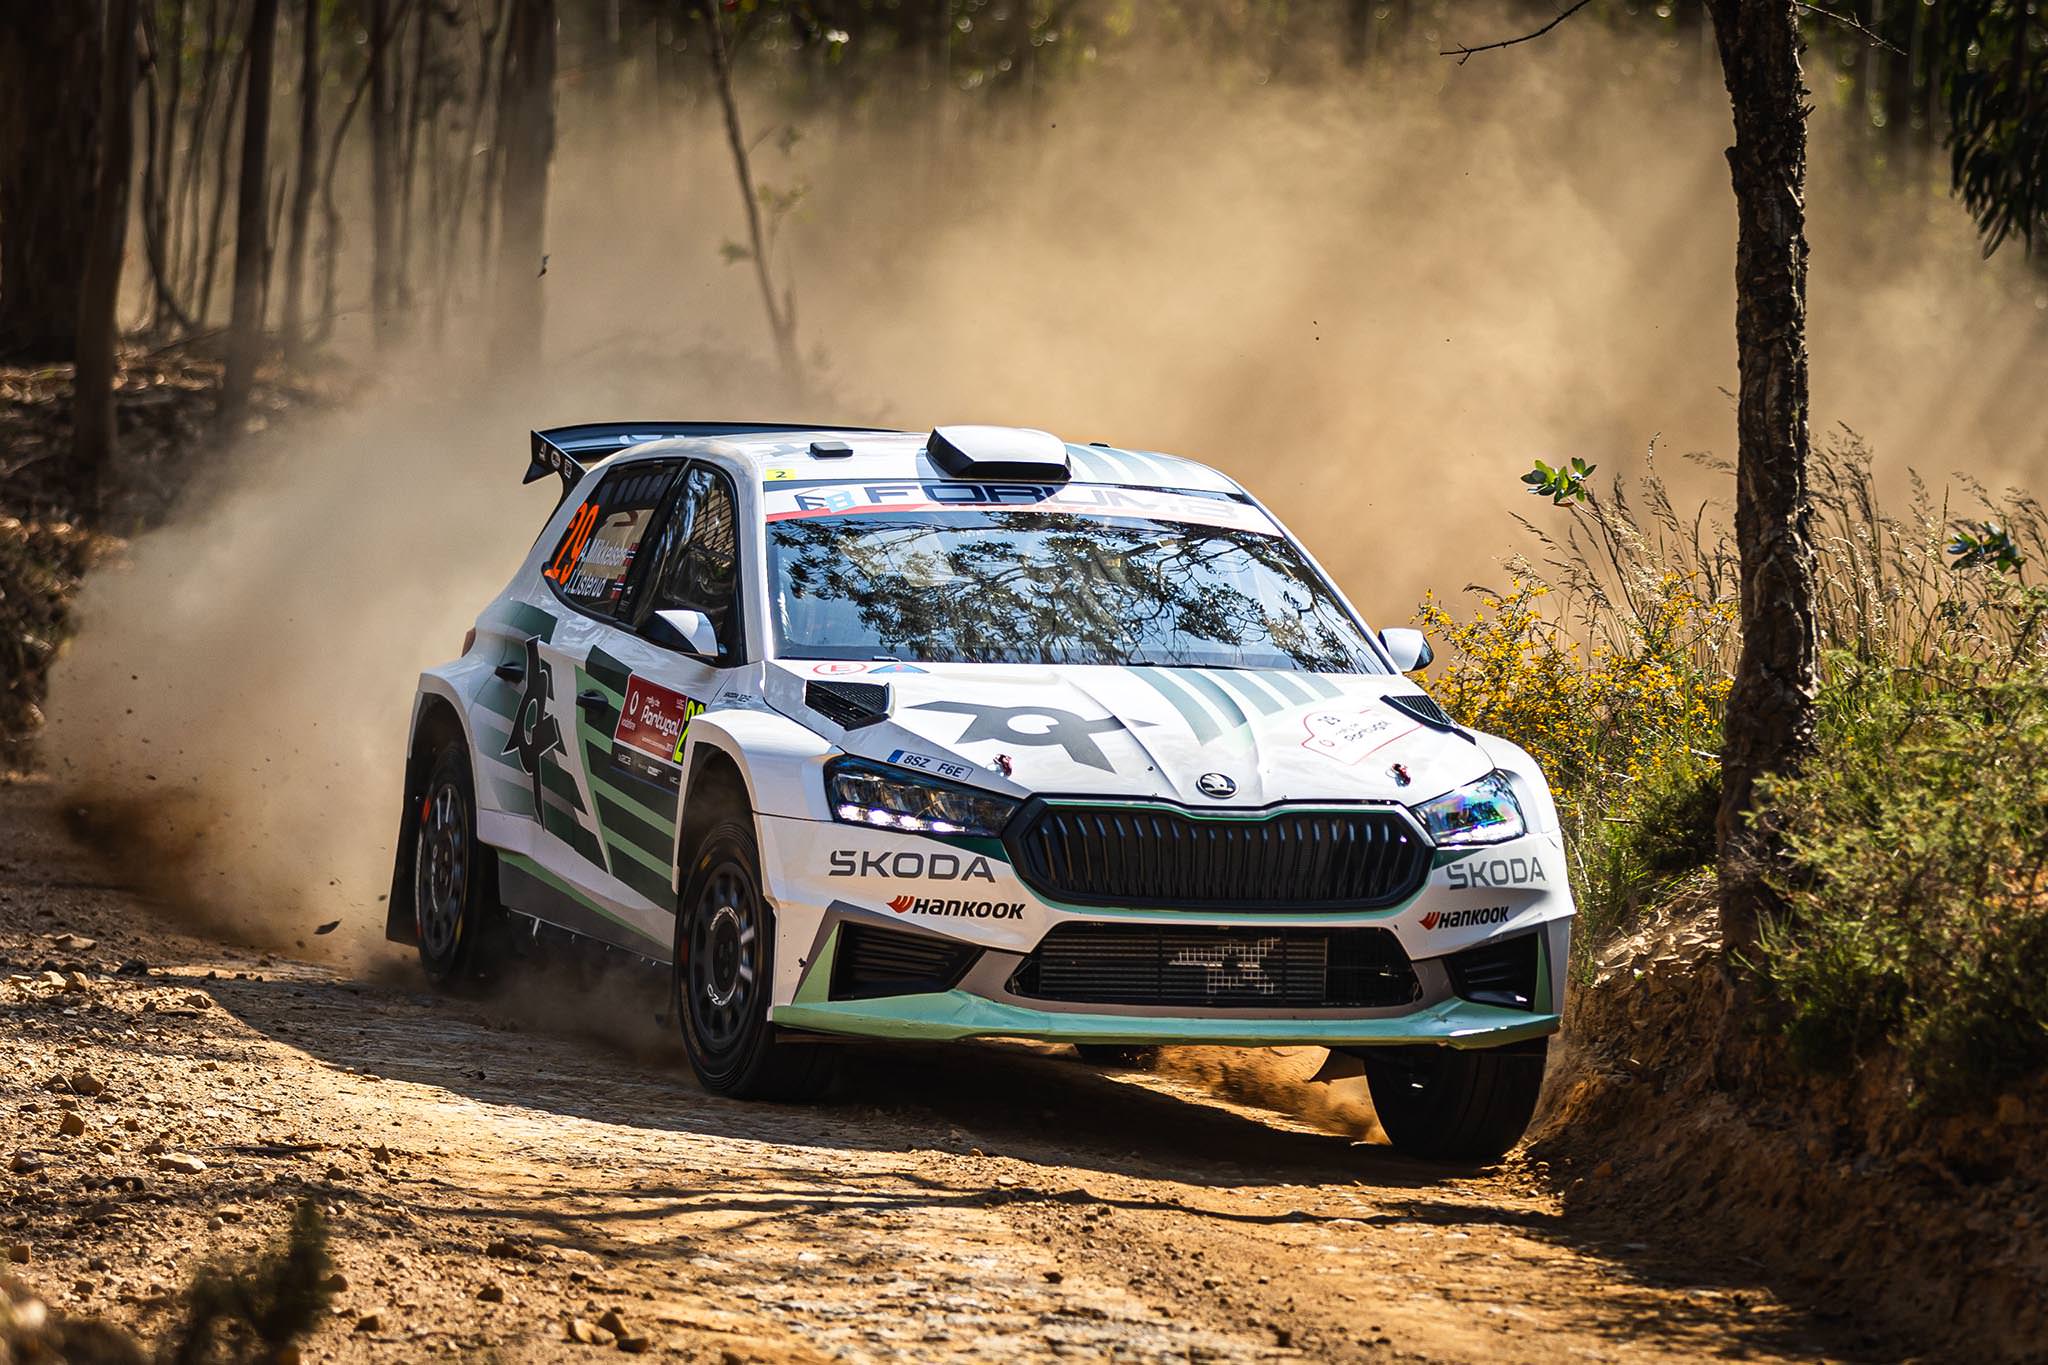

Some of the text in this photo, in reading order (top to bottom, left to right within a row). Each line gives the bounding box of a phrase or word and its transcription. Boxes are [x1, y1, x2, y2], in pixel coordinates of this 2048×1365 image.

[776, 470, 786, 479] 2
[543, 502, 600, 587] 29
[640, 704, 681, 737] Portugal
[674, 700, 705, 763] 2
[903, 754, 965, 778] 8SZ F6E
